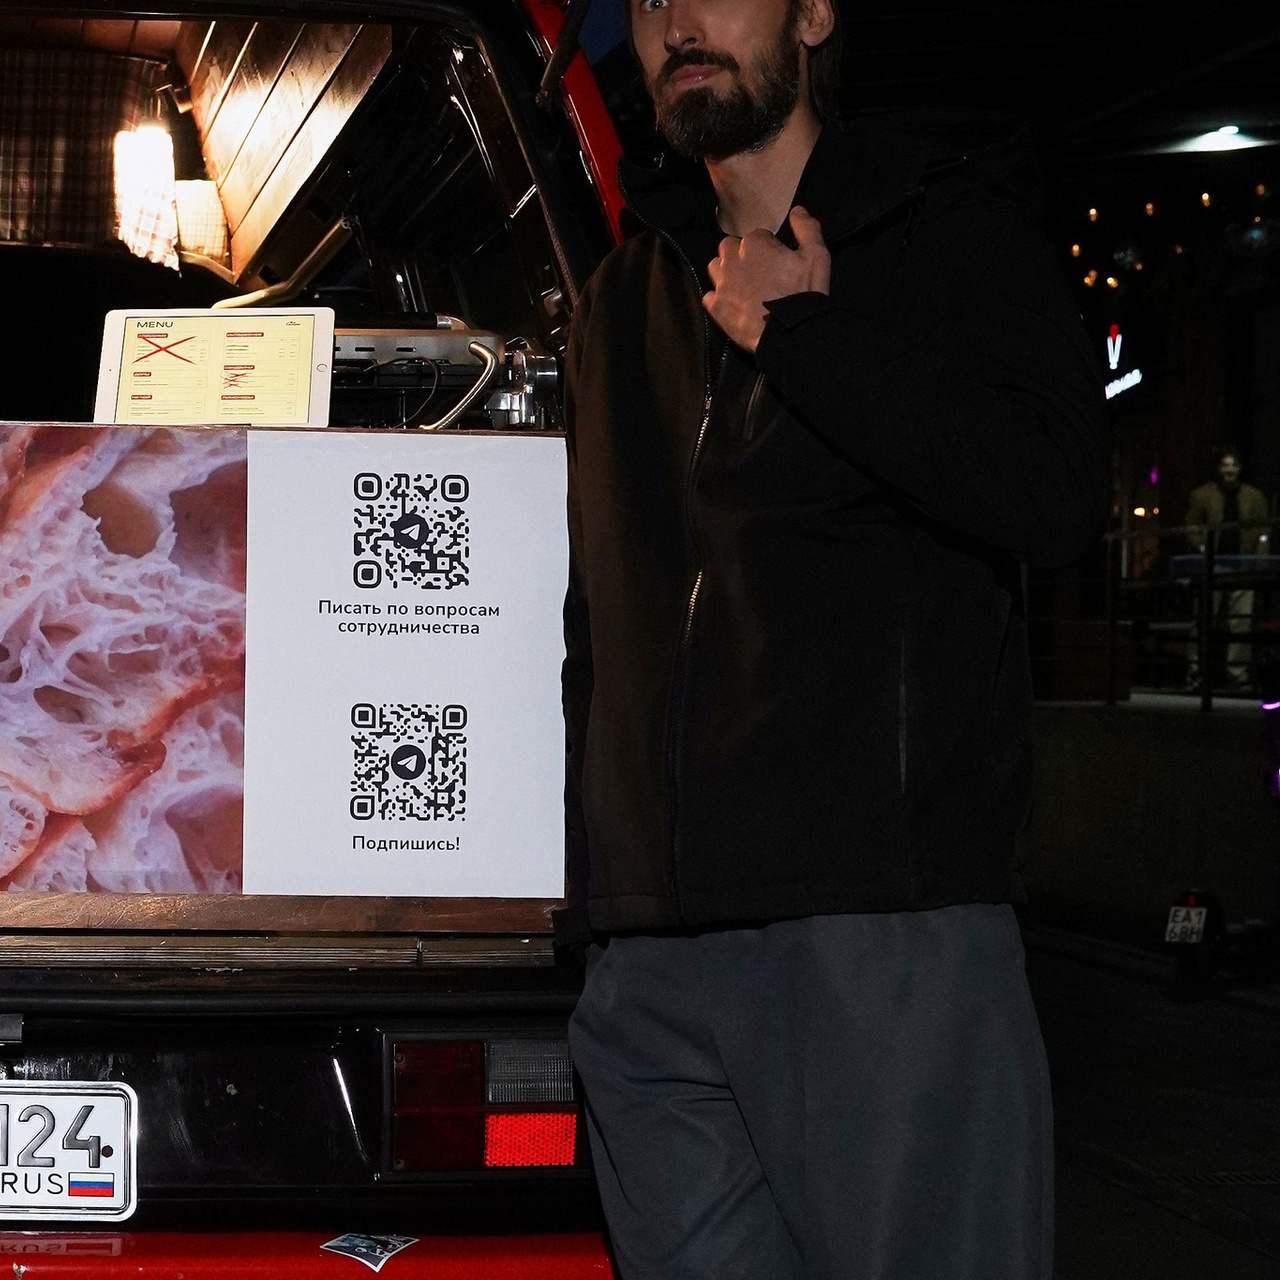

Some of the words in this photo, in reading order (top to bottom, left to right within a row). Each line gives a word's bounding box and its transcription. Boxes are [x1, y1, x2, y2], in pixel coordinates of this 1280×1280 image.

[318, 600, 381, 614] Писать
[387, 604, 409, 615] по
[414, 605, 500, 619] вопросам
[338, 622, 480, 636] сотрудничества
[352, 835, 461, 852] Подпишись!
[1, 1172, 64, 1195] RUS
